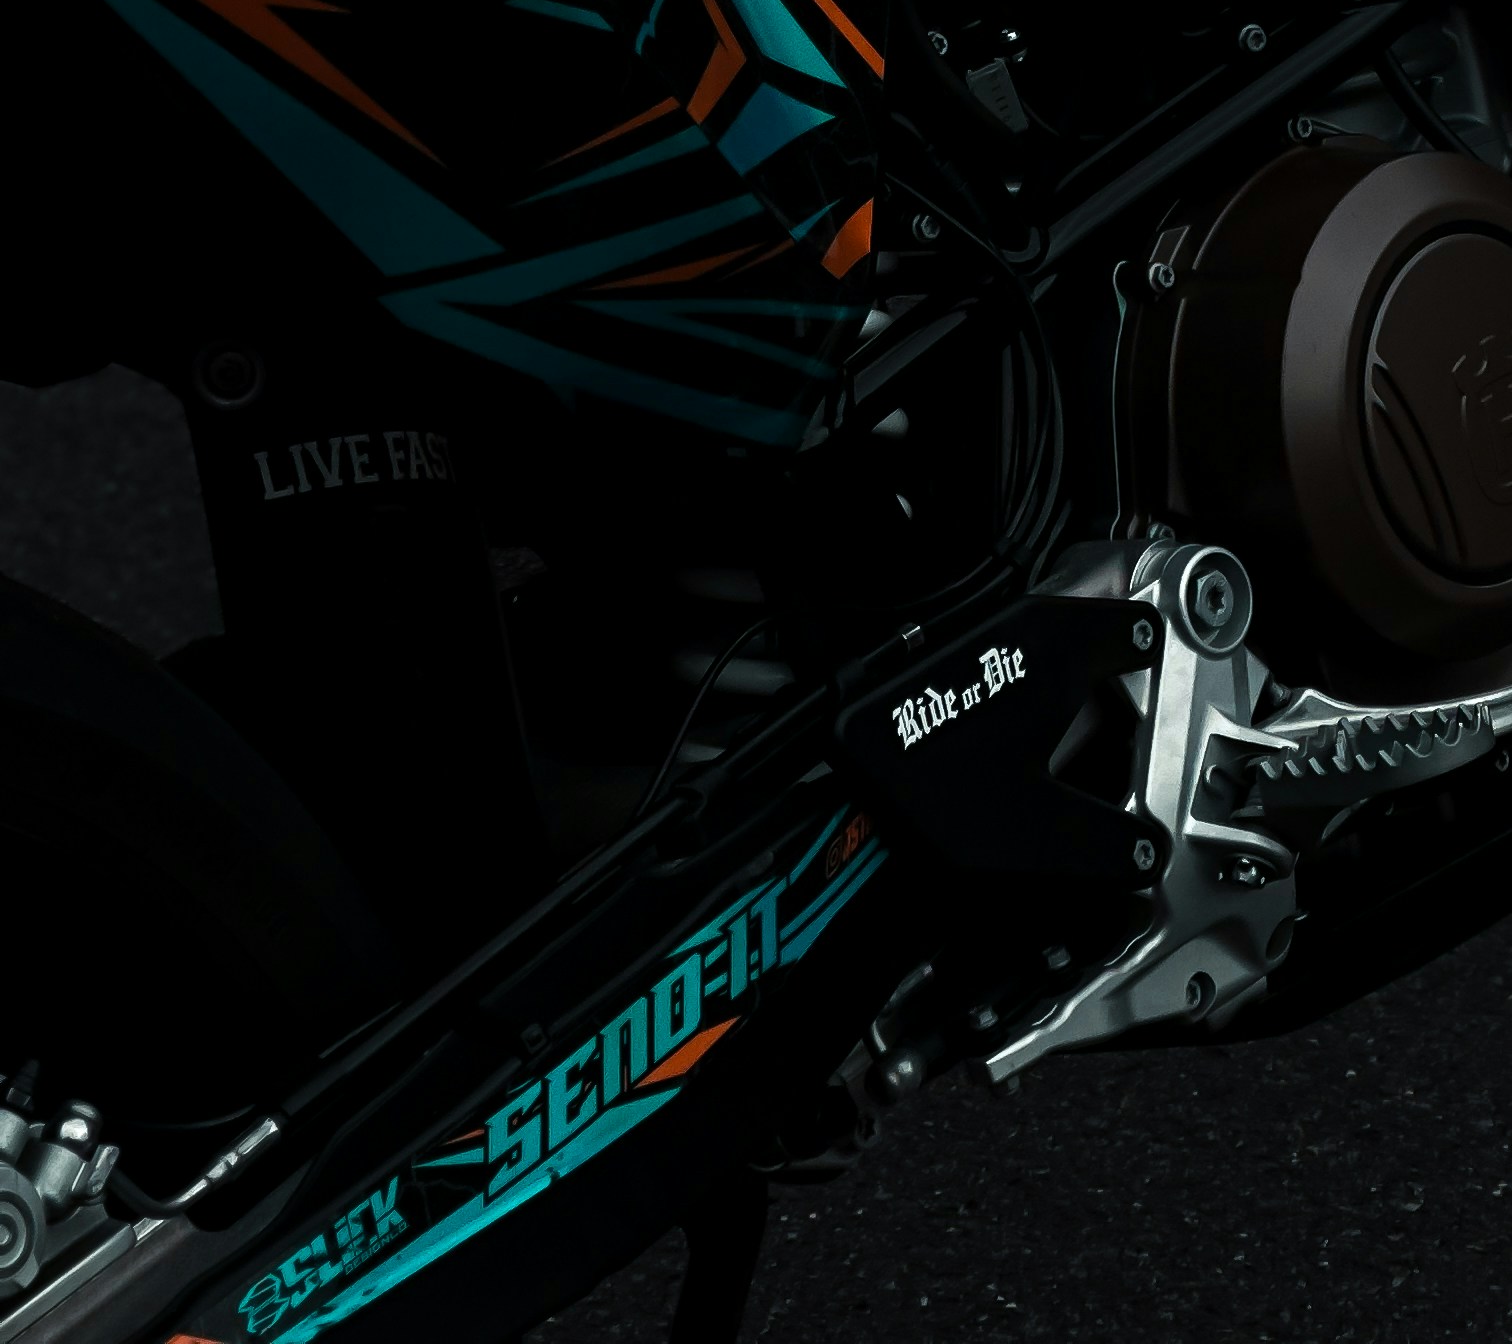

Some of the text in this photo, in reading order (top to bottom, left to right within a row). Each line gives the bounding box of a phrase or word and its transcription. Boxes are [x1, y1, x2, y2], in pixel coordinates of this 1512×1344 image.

[253, 432, 380, 501] LIVE
[893, 648, 1027, 752] Ride or Die
[277, 1176, 404, 1310] SLICK
